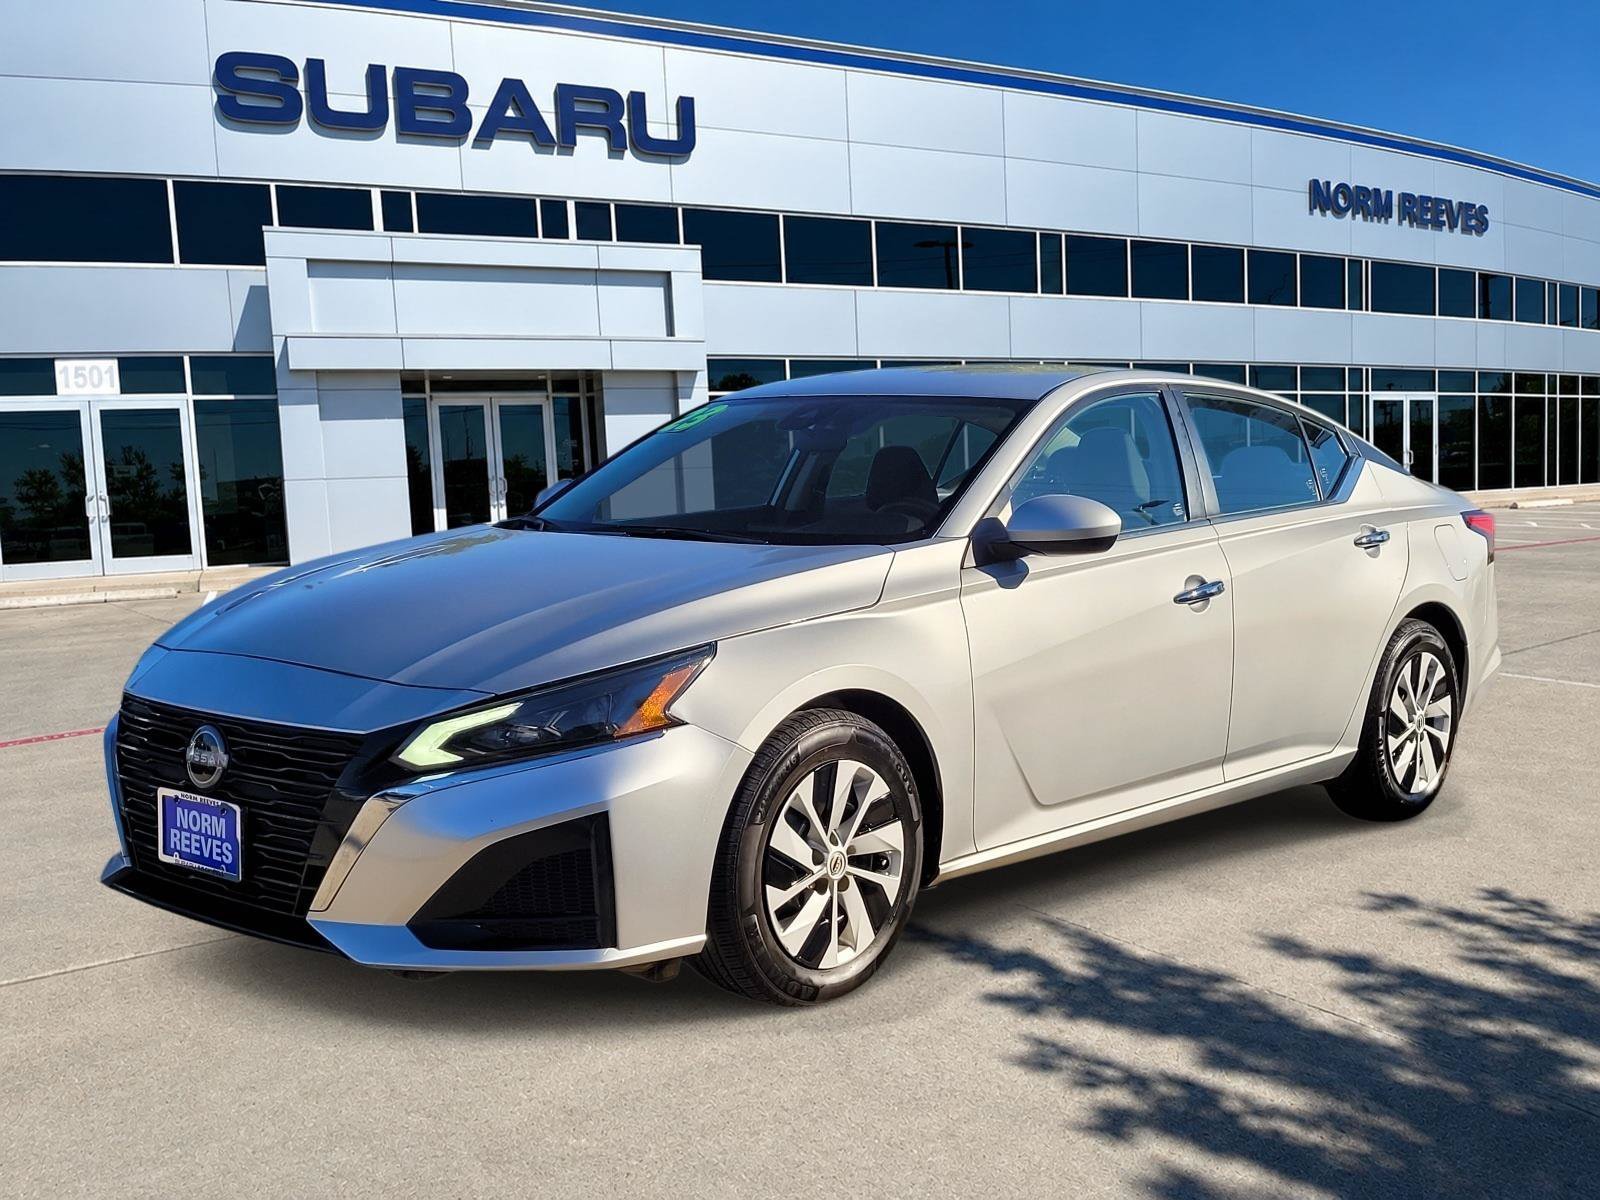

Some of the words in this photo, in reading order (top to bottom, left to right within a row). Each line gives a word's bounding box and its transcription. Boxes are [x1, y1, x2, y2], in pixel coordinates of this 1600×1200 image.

[214, 51, 696, 160] SUBARU
[1309, 178, 1394, 224] NORM
[1398, 192, 1490, 237] REEVES
[59, 365, 115, 389] 1501
[187, 748, 228, 768] SSAN
[176, 806, 226, 839] NORM
[170, 828, 233, 864] REEVES
